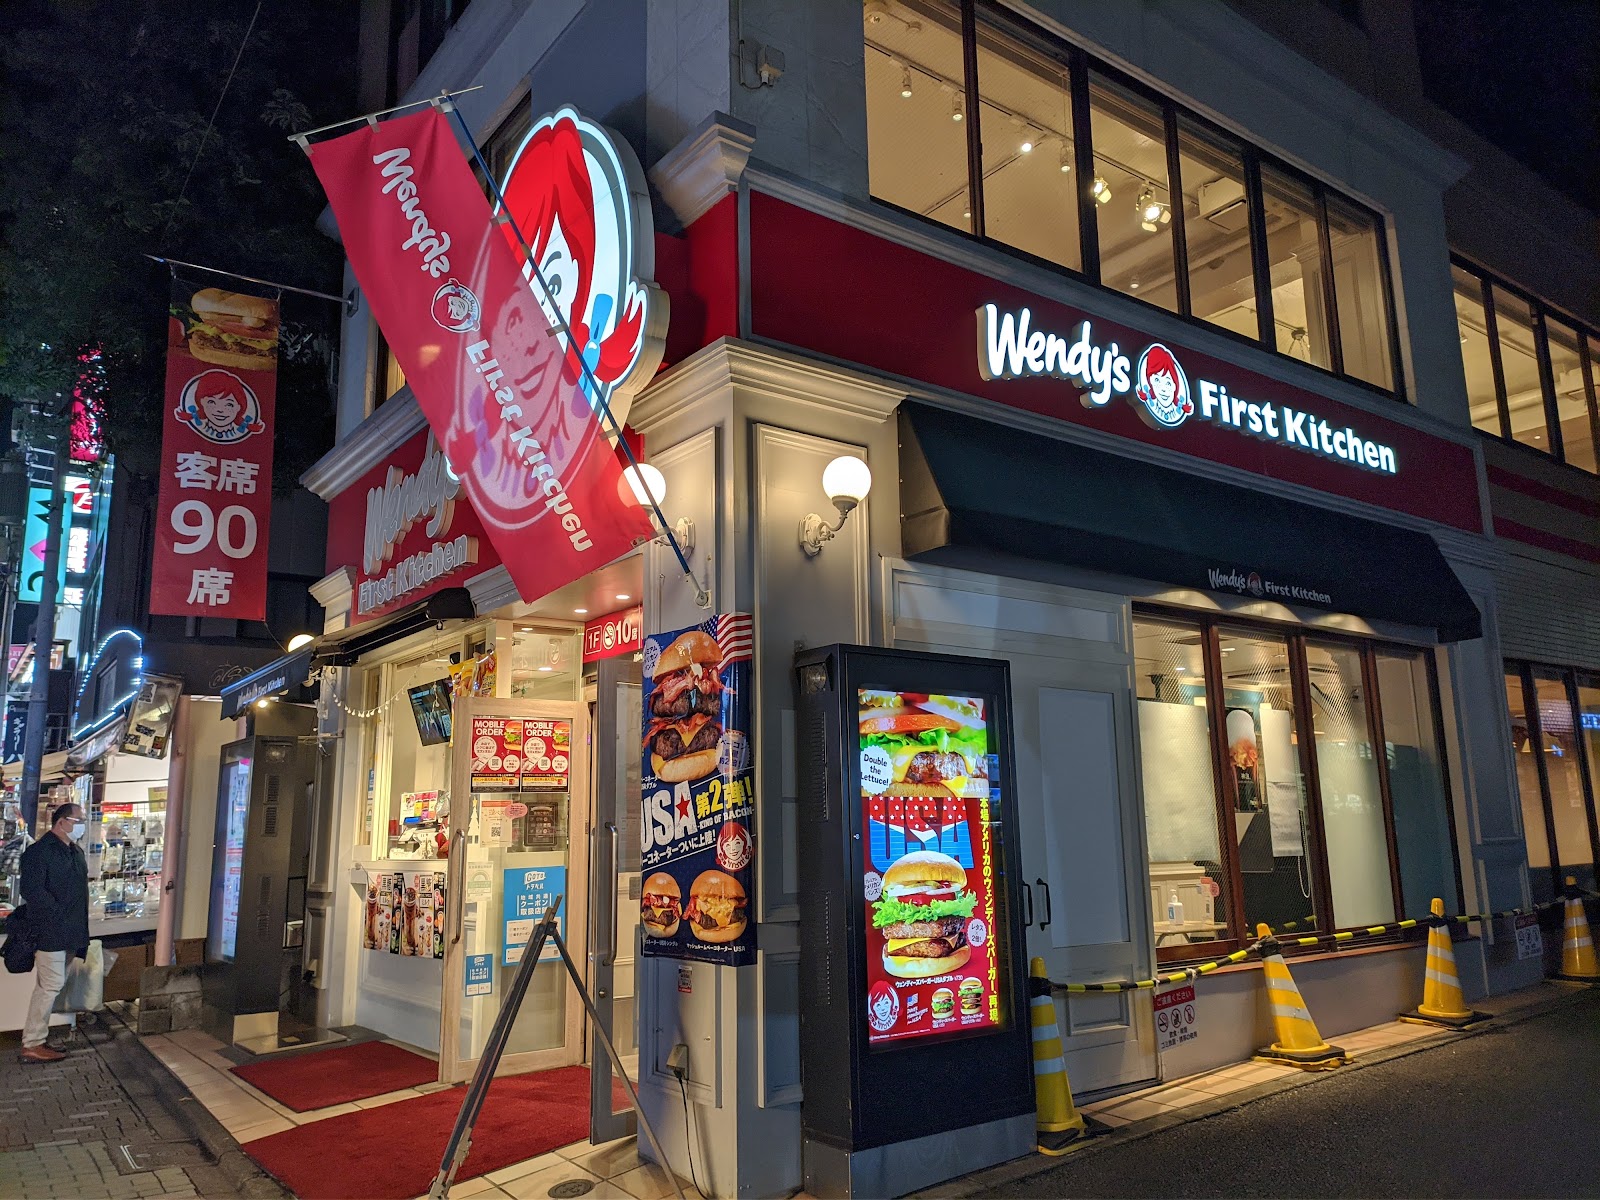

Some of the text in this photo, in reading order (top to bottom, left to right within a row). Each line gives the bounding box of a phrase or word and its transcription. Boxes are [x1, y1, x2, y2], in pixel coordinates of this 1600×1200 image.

[985, 303, 1396, 474] Wendy's First Kitchen
[174, 451, 259, 495] 客席
[170, 500, 258, 559] 90
[186, 567, 234, 606] 席
[358, 534, 468, 615] First Kitchen
[1208, 567, 1332, 604] Wendy's First Kitchen
[588, 630, 600, 650] 1F
[474, 720, 505, 729] MOBILE
[475, 728, 504, 736] ORDER
[524, 721, 554, 730] MOBILE
[525, 729, 553, 737] ORDER
[863, 754, 888, 767] Double
[869, 764, 882, 775] the
[861, 771, 889, 787] Lettuce!
[695, 776, 754, 820] 第2弾!
[641, 780, 698, 853] USA
[869, 796, 974, 873] USA
[520, 899, 549, 908] クーポン
